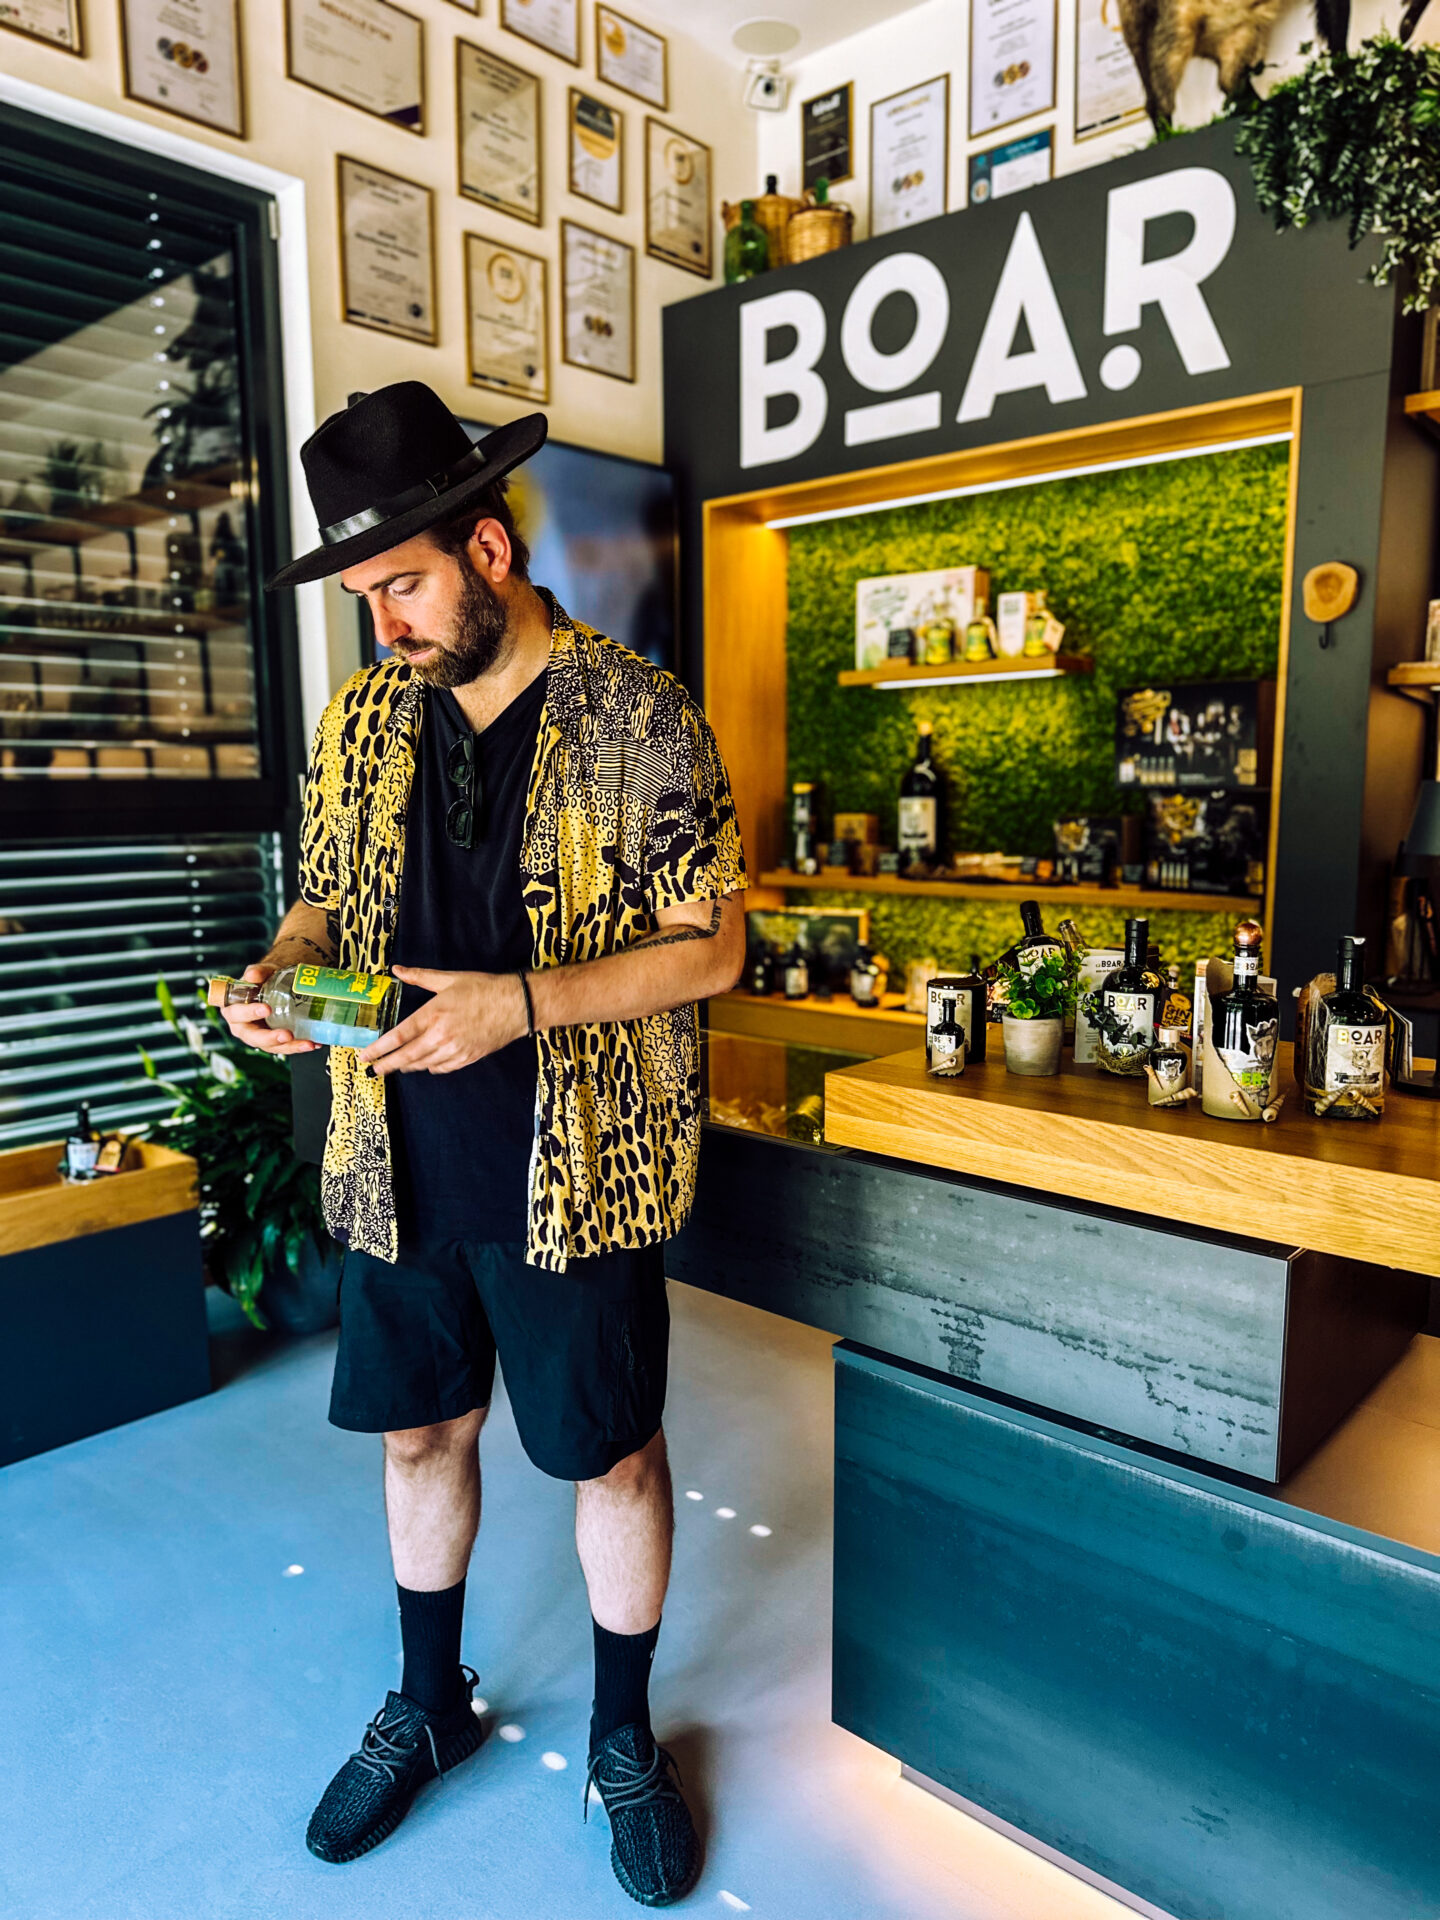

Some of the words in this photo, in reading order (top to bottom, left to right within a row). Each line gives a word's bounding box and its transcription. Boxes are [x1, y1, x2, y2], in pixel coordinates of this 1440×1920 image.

[740, 166, 1237, 469] BOAR
[1101, 960, 1122, 968] BOAR
[931, 991, 966, 1005] BR
[1108, 995, 1147, 1010] BOAR
[1337, 1029, 1383, 1045] BOAR
